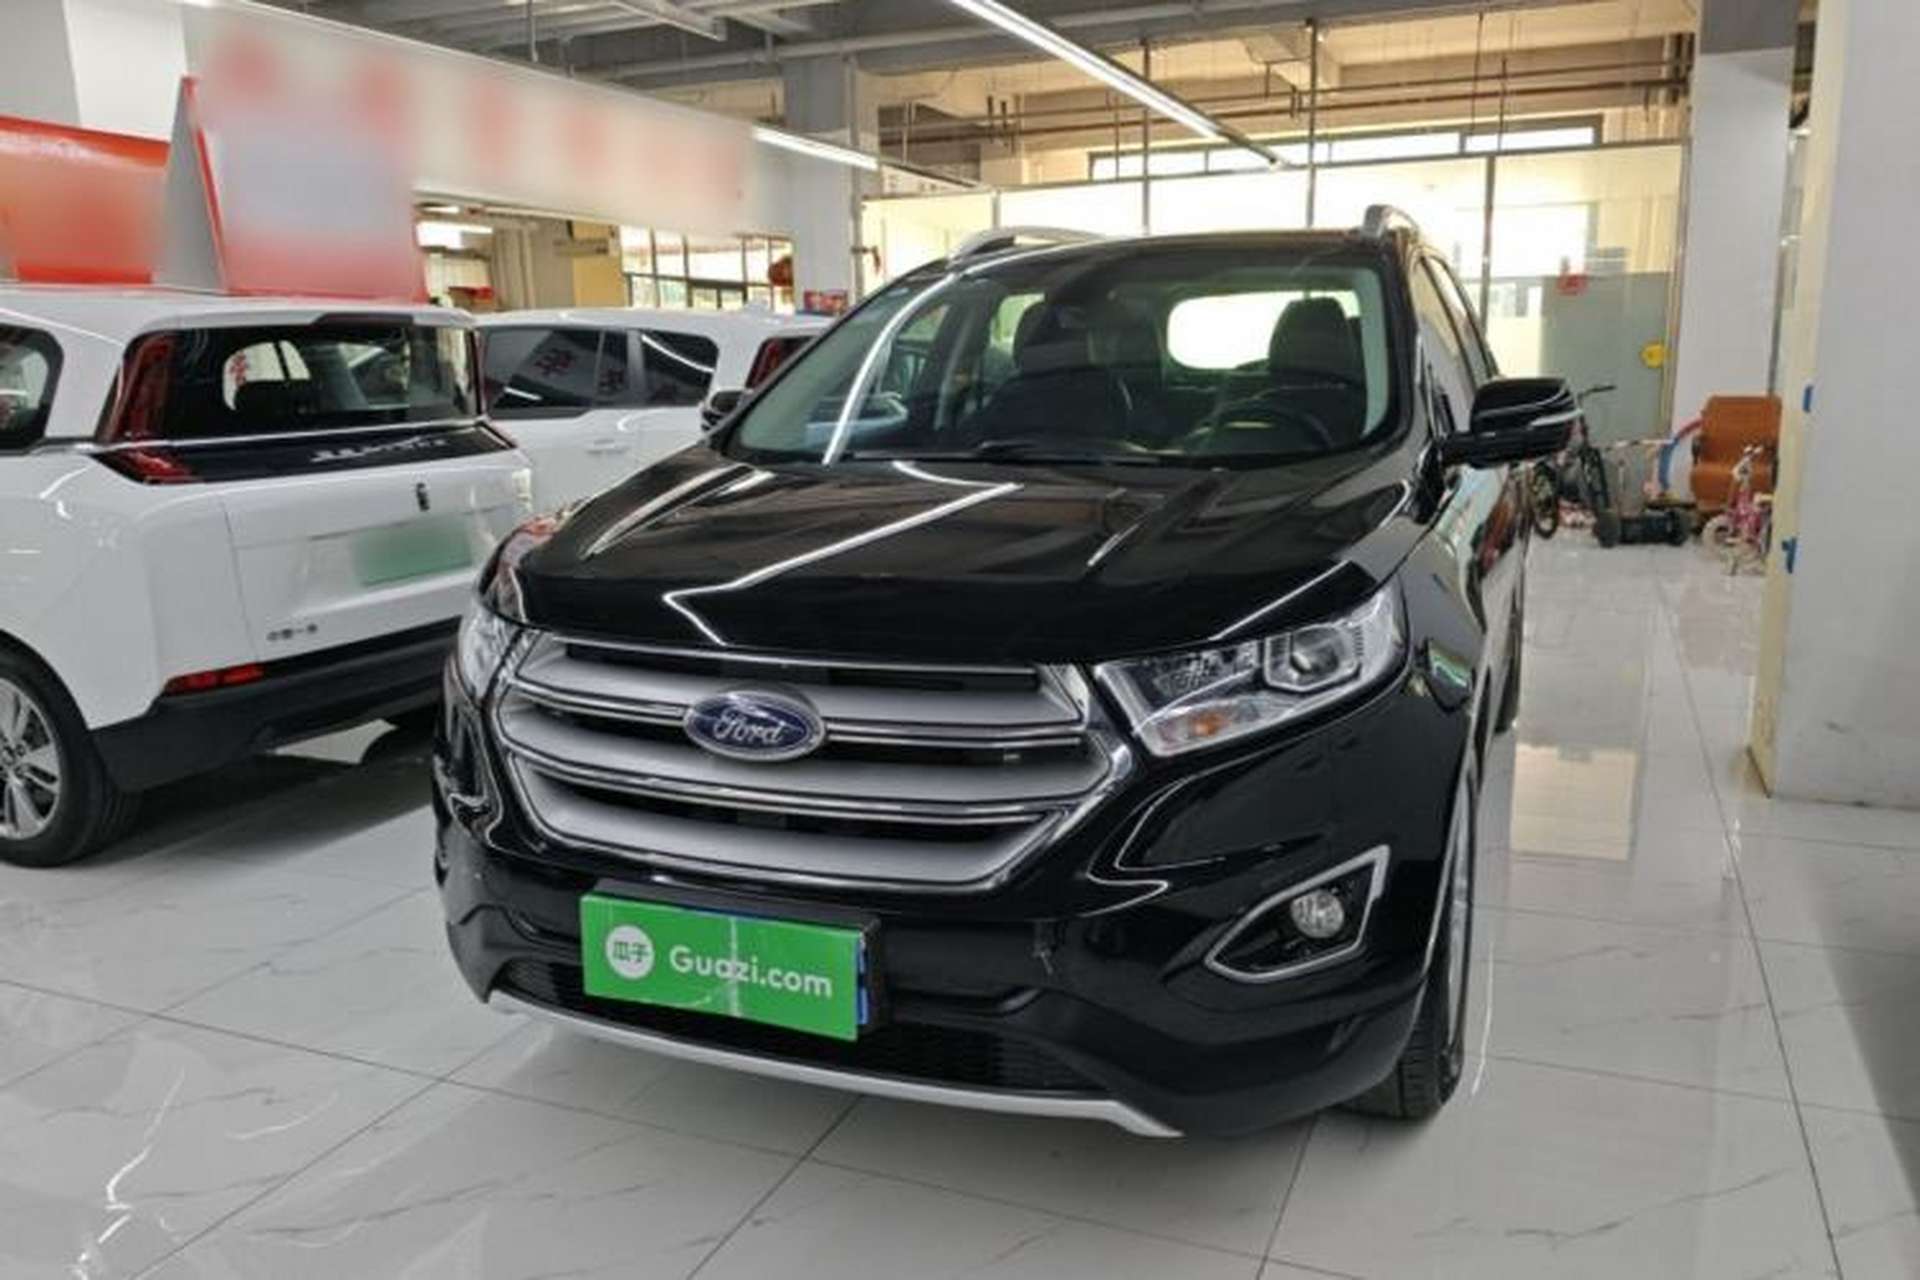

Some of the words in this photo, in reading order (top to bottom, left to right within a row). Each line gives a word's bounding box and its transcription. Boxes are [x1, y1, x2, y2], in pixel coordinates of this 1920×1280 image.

[711, 706, 788, 746] Ford
[611, 940, 650, 963] 瓜子
[669, 946, 833, 998] Guazi.com
